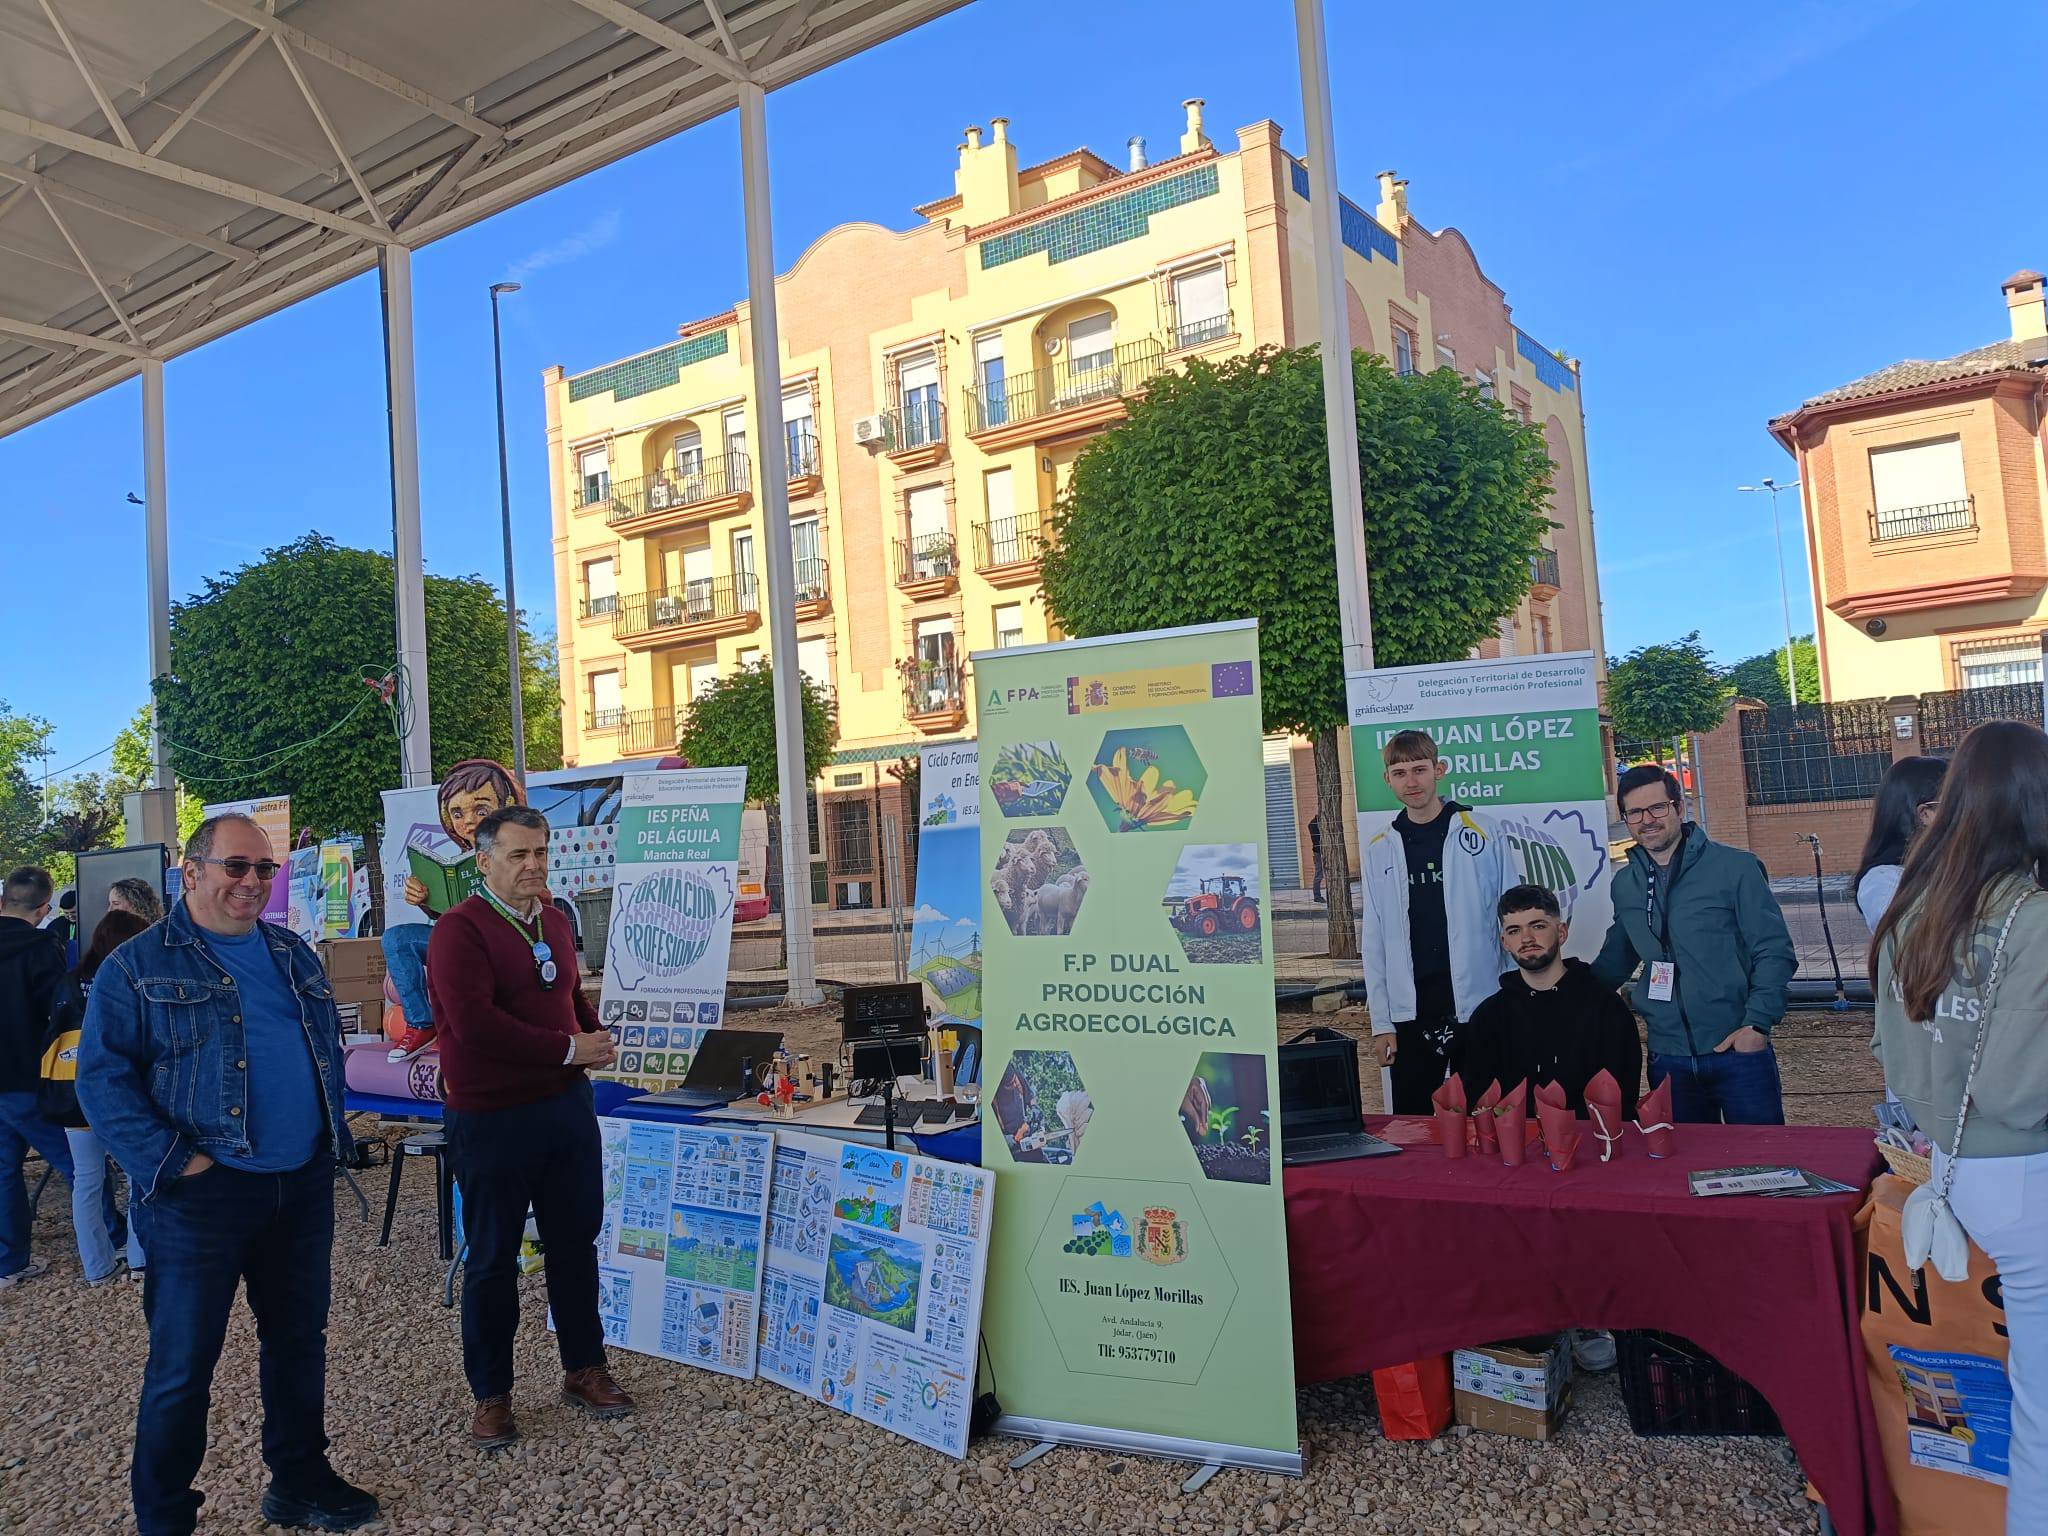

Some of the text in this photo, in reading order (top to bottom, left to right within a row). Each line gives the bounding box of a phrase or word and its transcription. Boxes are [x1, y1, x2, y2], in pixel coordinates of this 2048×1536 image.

[1418, 667, 1586, 688] Delegación Territorial de Desarrollo
[1420, 678, 1582, 698] Educativo y Formación Profesional
[1419, 724, 1482, 746] UAN
[1491, 716, 1574, 742] LÓPEZ
[927, 752, 949, 768] Ciclo
[1438, 750, 1541, 774] ORILLAS
[951, 772, 980, 788] en Ene
[1450, 781, 1504, 801] Jódar
[250, 803, 277, 813] Nuestra
[647, 805, 710, 824] IES PEÑA
[962, 805, 973, 816] IES
[637, 826, 721, 845] DEL ÁGUILA
[643, 848, 710, 861] Mancha Real
[1408, 871, 1444, 885] NIK
[1064, 954, 1179, 973] F.P DUAL
[673, 987, 710, 995] PROFESIONAL
[1042, 984, 1205, 1004] PRODUCCIóN
[1935, 992, 1980, 1022] LES
[1059, 1278, 1204, 1306] IES. Juan López Morillas
[1098, 1343, 1176, 1365] Tlf: 953779710
